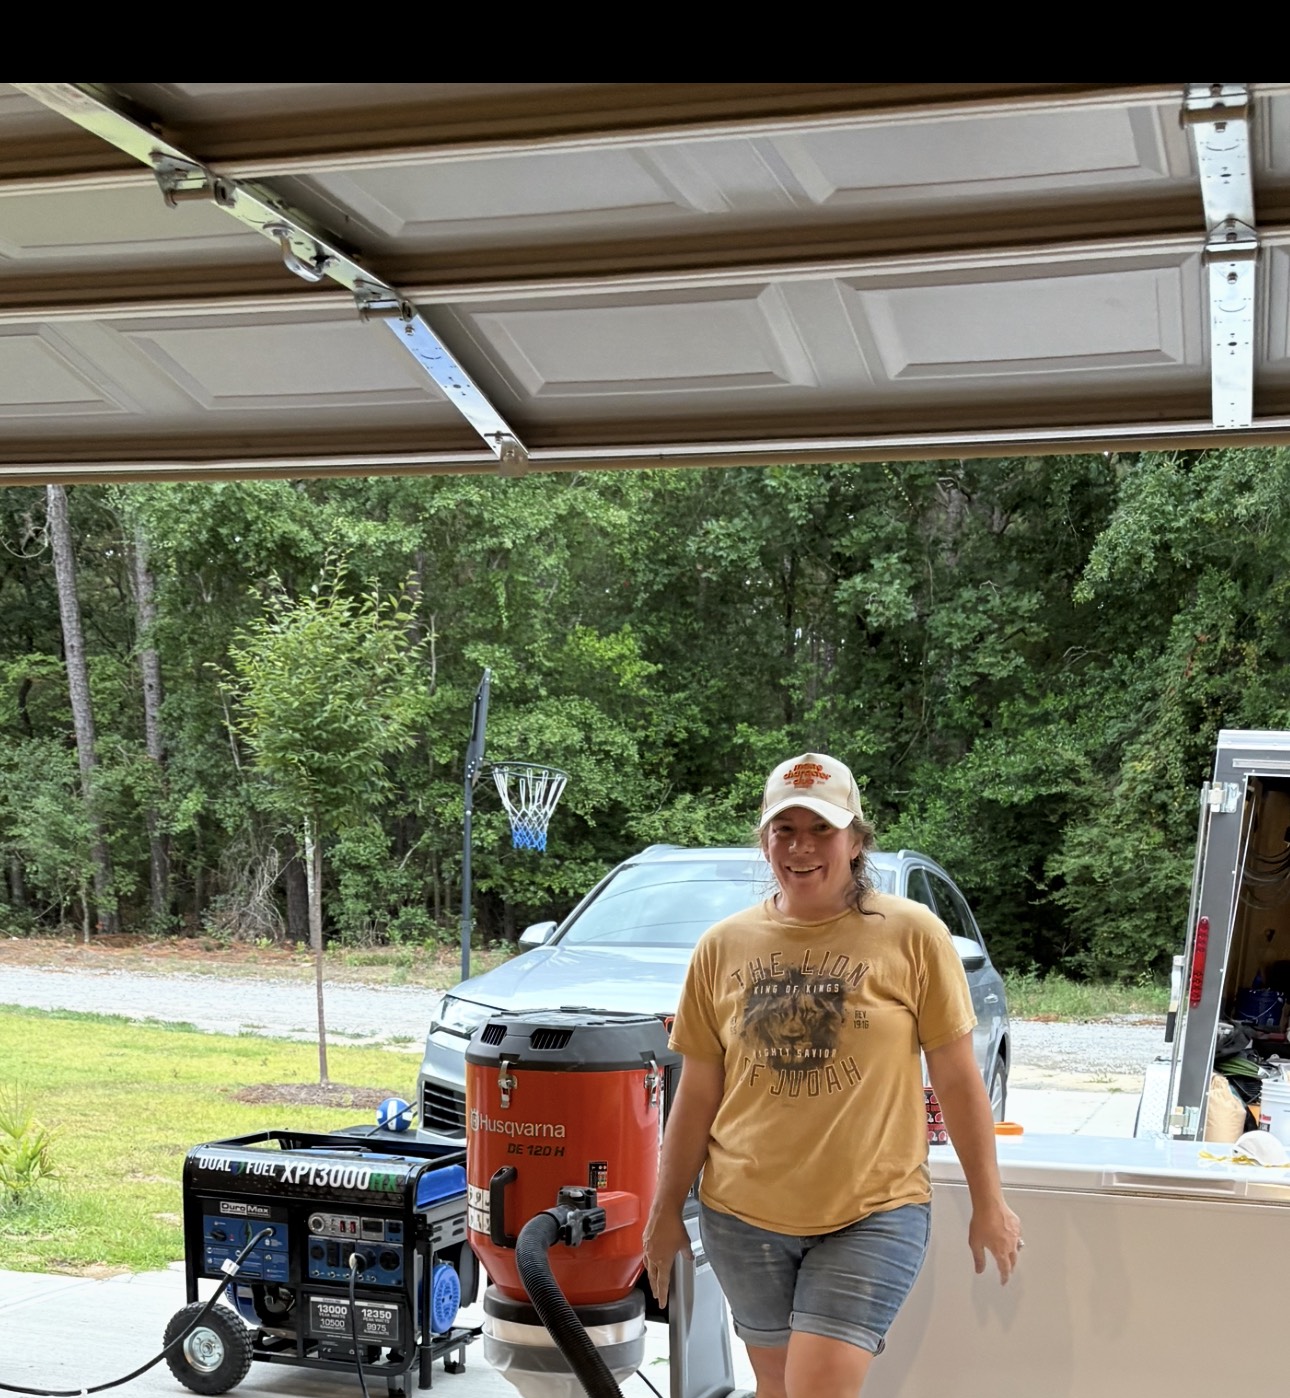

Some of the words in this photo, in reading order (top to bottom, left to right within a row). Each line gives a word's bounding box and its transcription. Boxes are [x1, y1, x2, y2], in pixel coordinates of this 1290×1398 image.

[731, 951, 784, 989] THE
[801, 949, 870, 987] LION
[754, 984, 778, 994] KING
[785, 984, 799, 993] OF
[806, 983, 839, 993] KINGS
[796, 1048, 837, 1058] SAVIOR
[769, 1056, 862, 1098] JUDAH
[480, 1113, 566, 1138] Husqvarna
[507, 1143, 523, 1155] DE
[527, 1145, 552, 1156] 120
[554, 1146, 565, 1157] H
[199, 1156, 231, 1172] DUAL
[246, 1161, 276, 1177] FUEL
[317, 1304, 348, 1315] 13000
[361, 1309, 392, 1320] 12350
[320, 1318, 345, 1328] 10500
[366, 1323, 387, 1332] 9975
